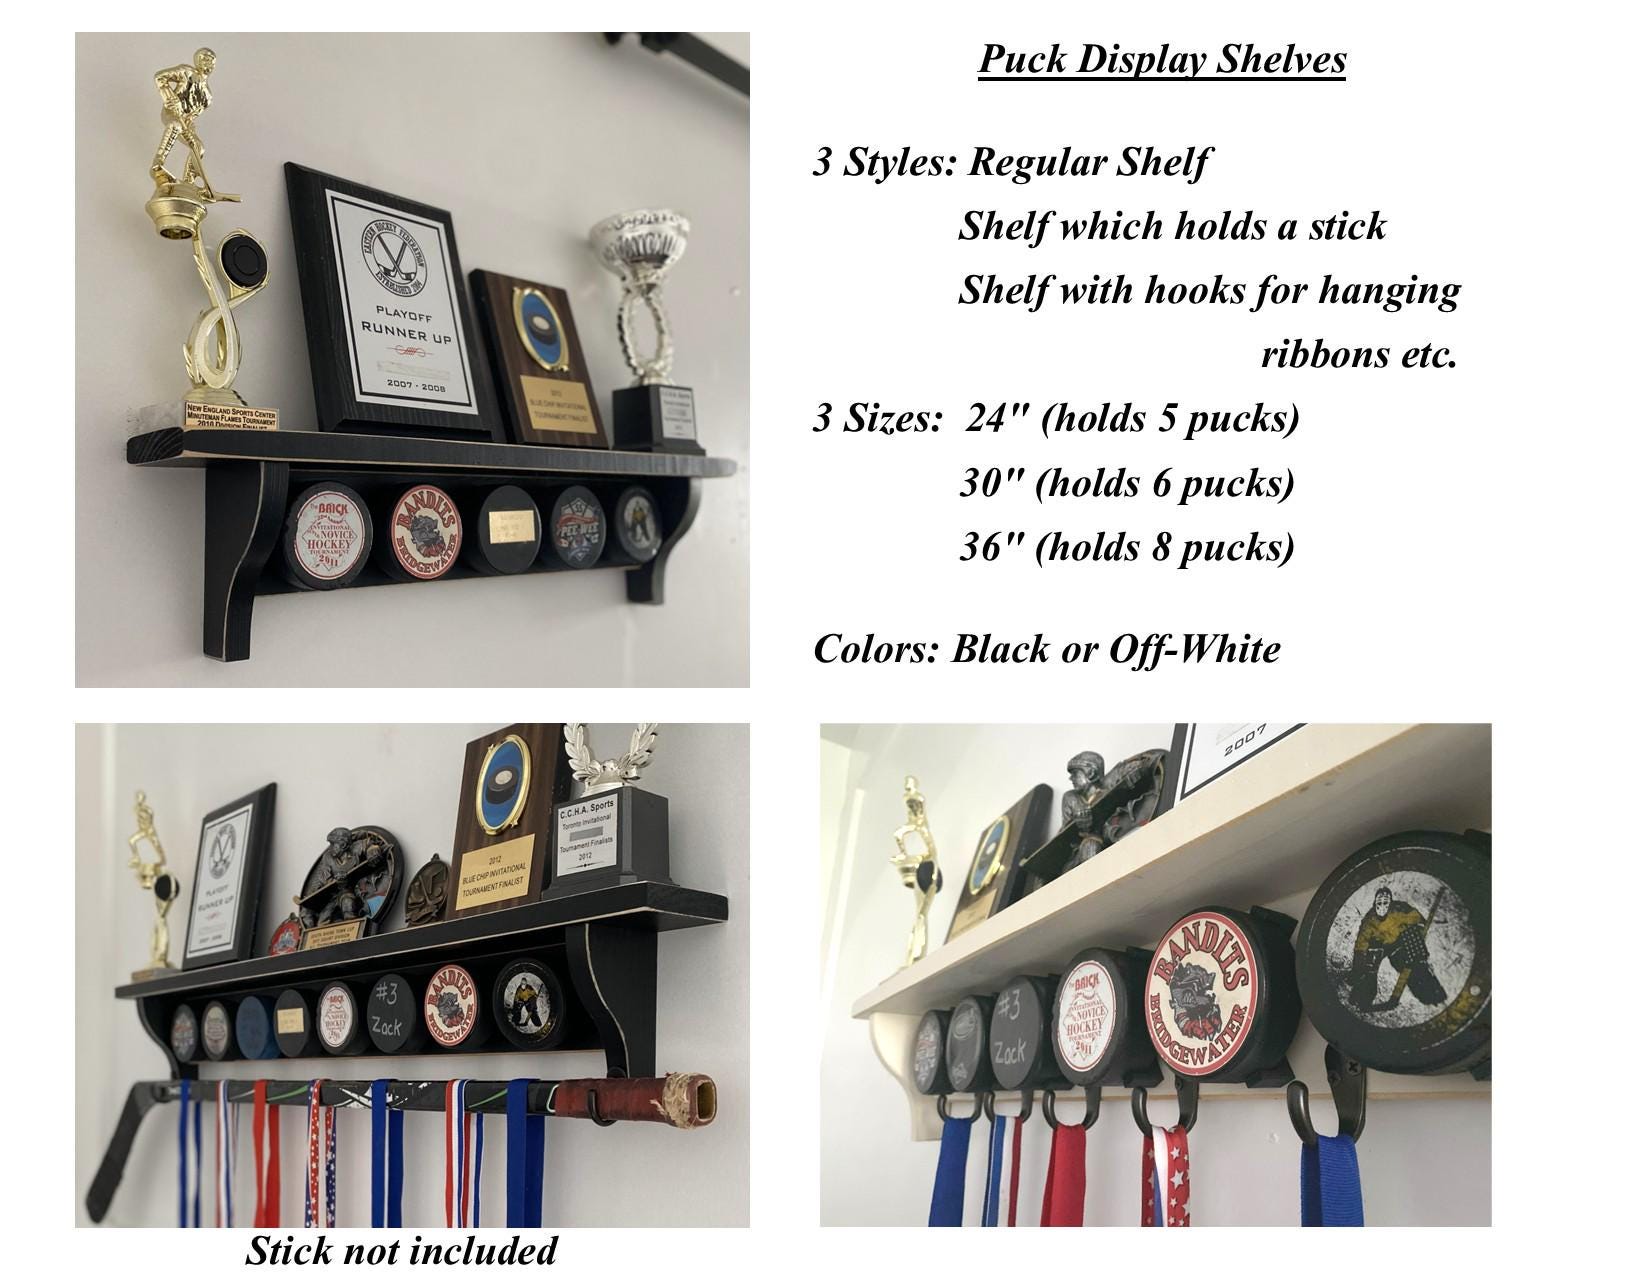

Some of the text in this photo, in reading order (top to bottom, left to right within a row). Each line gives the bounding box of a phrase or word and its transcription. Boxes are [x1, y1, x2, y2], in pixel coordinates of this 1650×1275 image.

[376, 305, 432, 323] PLAYOFF
[361, 321, 452, 344] RUNNER UP
[387, 379, 412, 389] 2007
[422, 384, 446, 393] 2008
[319, 503, 349, 516] BRICK
[396, 490, 456, 531] BANDITS
[308, 539, 351, 549] HOCKEY
[321, 530, 354, 539] NOVICE
[319, 554, 339, 567] 2011
[397, 534, 457, 574] BRIDGEWATER
[1224, 723, 1267, 757] 2007
[590, 800, 614, 812] Sports
[560, 836, 613, 853] Tournament Finalists
[578, 852, 592, 861] 2012
[463, 862, 526, 885] BLUE CHIP INVITATIONAL
[463, 876, 524, 897] TOURNAMENT FINALIST
[1153, 920, 1250, 992] BANDITS
[428, 969, 473, 1008] BANDITS
[1075, 972, 1100, 991] BRICK
[376, 981, 398, 1005] #3
[998, 989, 1020, 1020] #3
[1077, 1005, 1106, 1021] NOVICE
[371, 1015, 403, 1037] Zack
[428, 1003, 474, 1041] BRIDGEWATER
[1067, 1018, 1103, 1037] HOCKEY
[1150, 993, 1248, 1066] BRIDGEWATER
